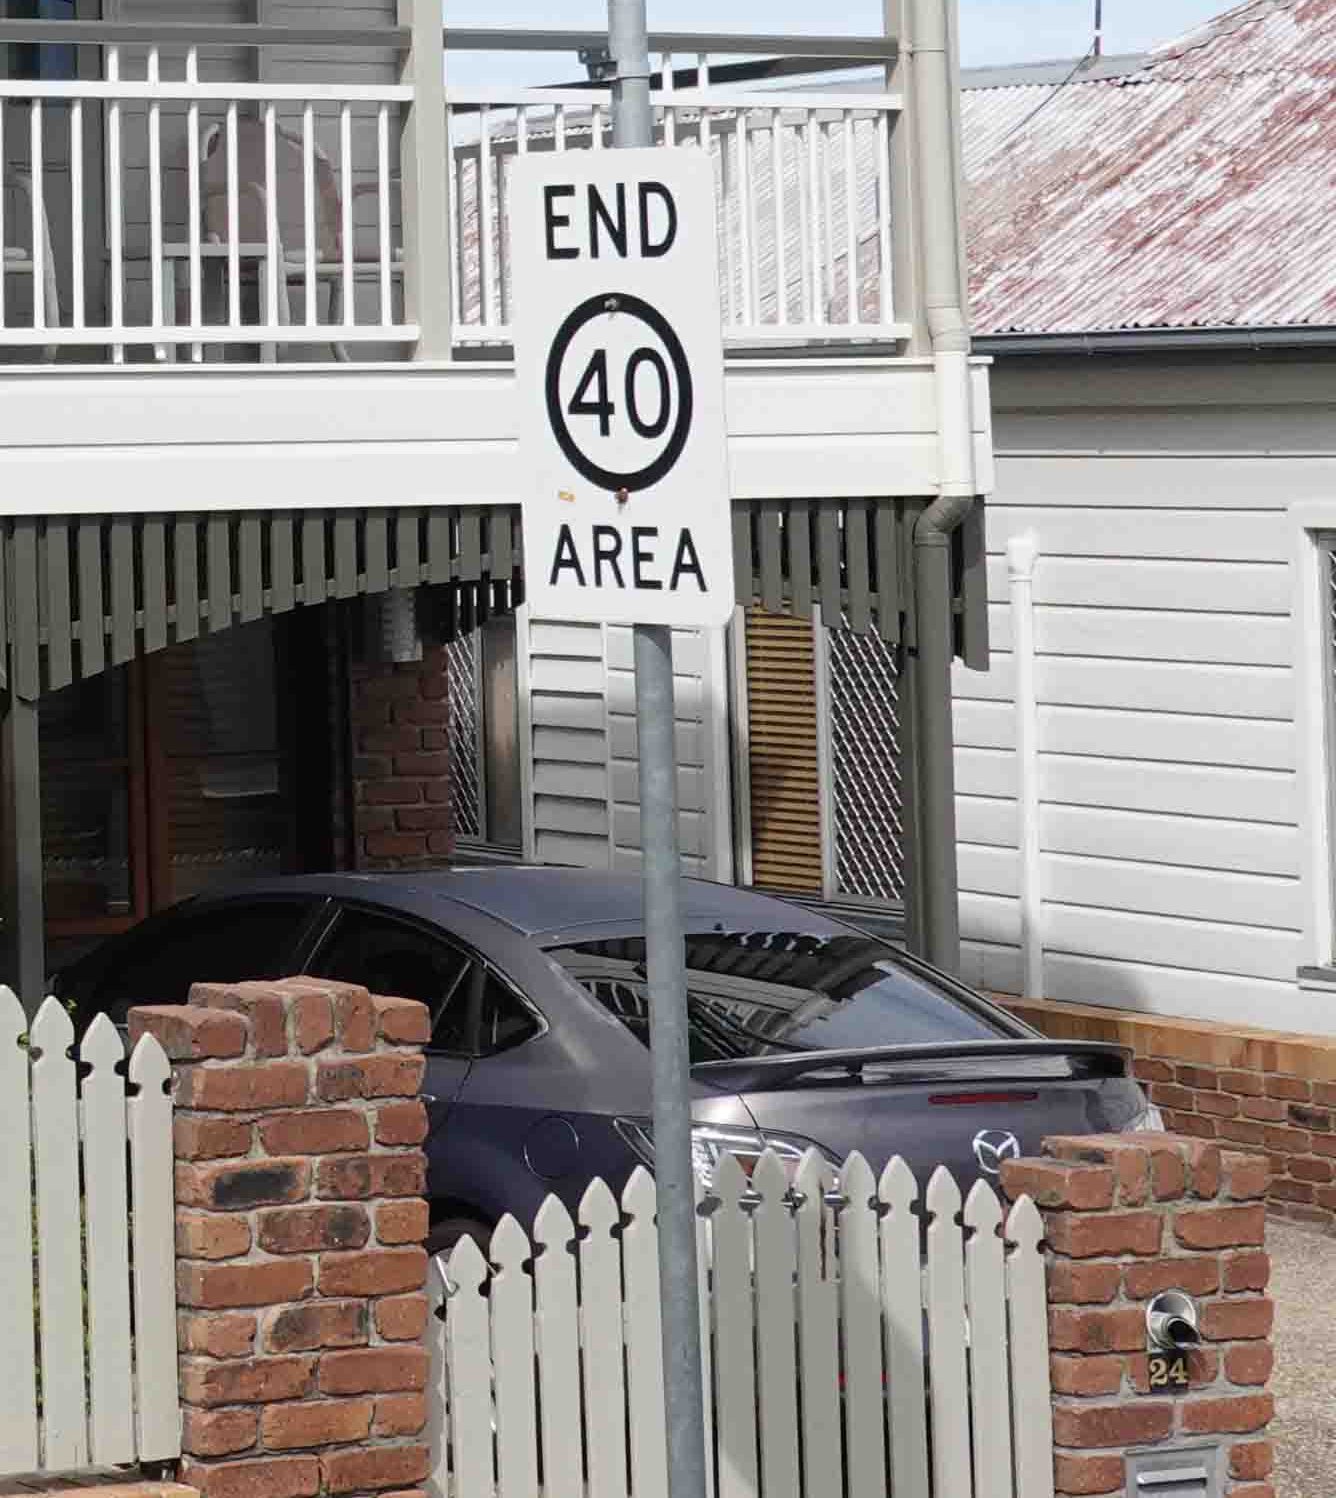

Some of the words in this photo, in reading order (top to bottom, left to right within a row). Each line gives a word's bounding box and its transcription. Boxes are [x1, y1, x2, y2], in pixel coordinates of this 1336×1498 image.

[543, 181, 678, 259] END
[568, 347, 671, 439] 40
[550, 524, 708, 592] AREA
[1149, 1357, 1189, 1386] 24
